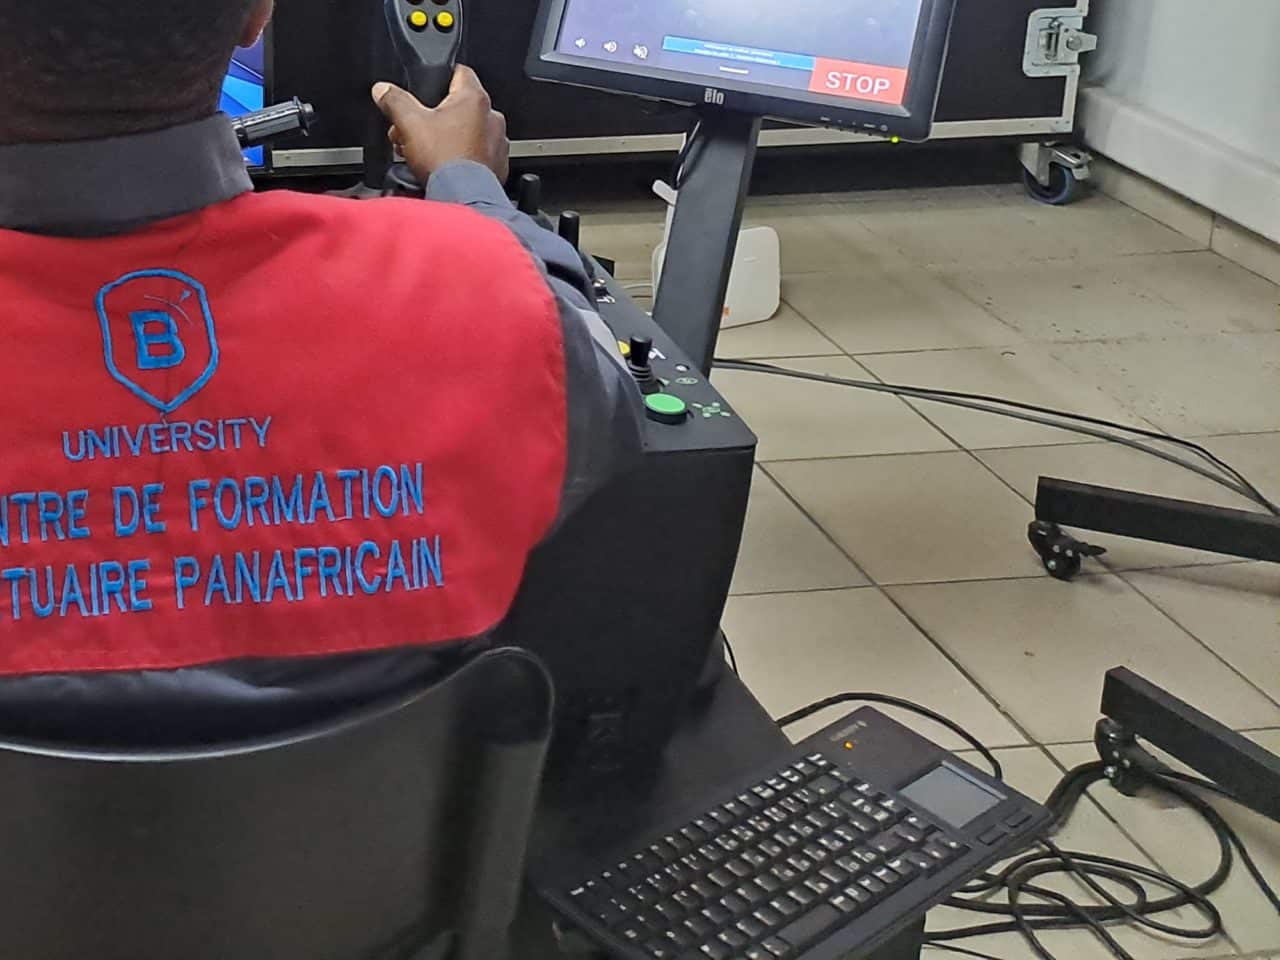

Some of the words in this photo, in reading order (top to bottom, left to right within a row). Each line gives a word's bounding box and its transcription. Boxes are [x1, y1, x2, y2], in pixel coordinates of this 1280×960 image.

[825, 71, 891, 96] STOP
[128, 309, 186, 370] B
[62, 416, 273, 462] UNIVERSITY
[112, 482, 167, 538] DE
[189, 462, 426, 532] FORMATION
[174, 535, 445, 610] PANAFRICAIN
